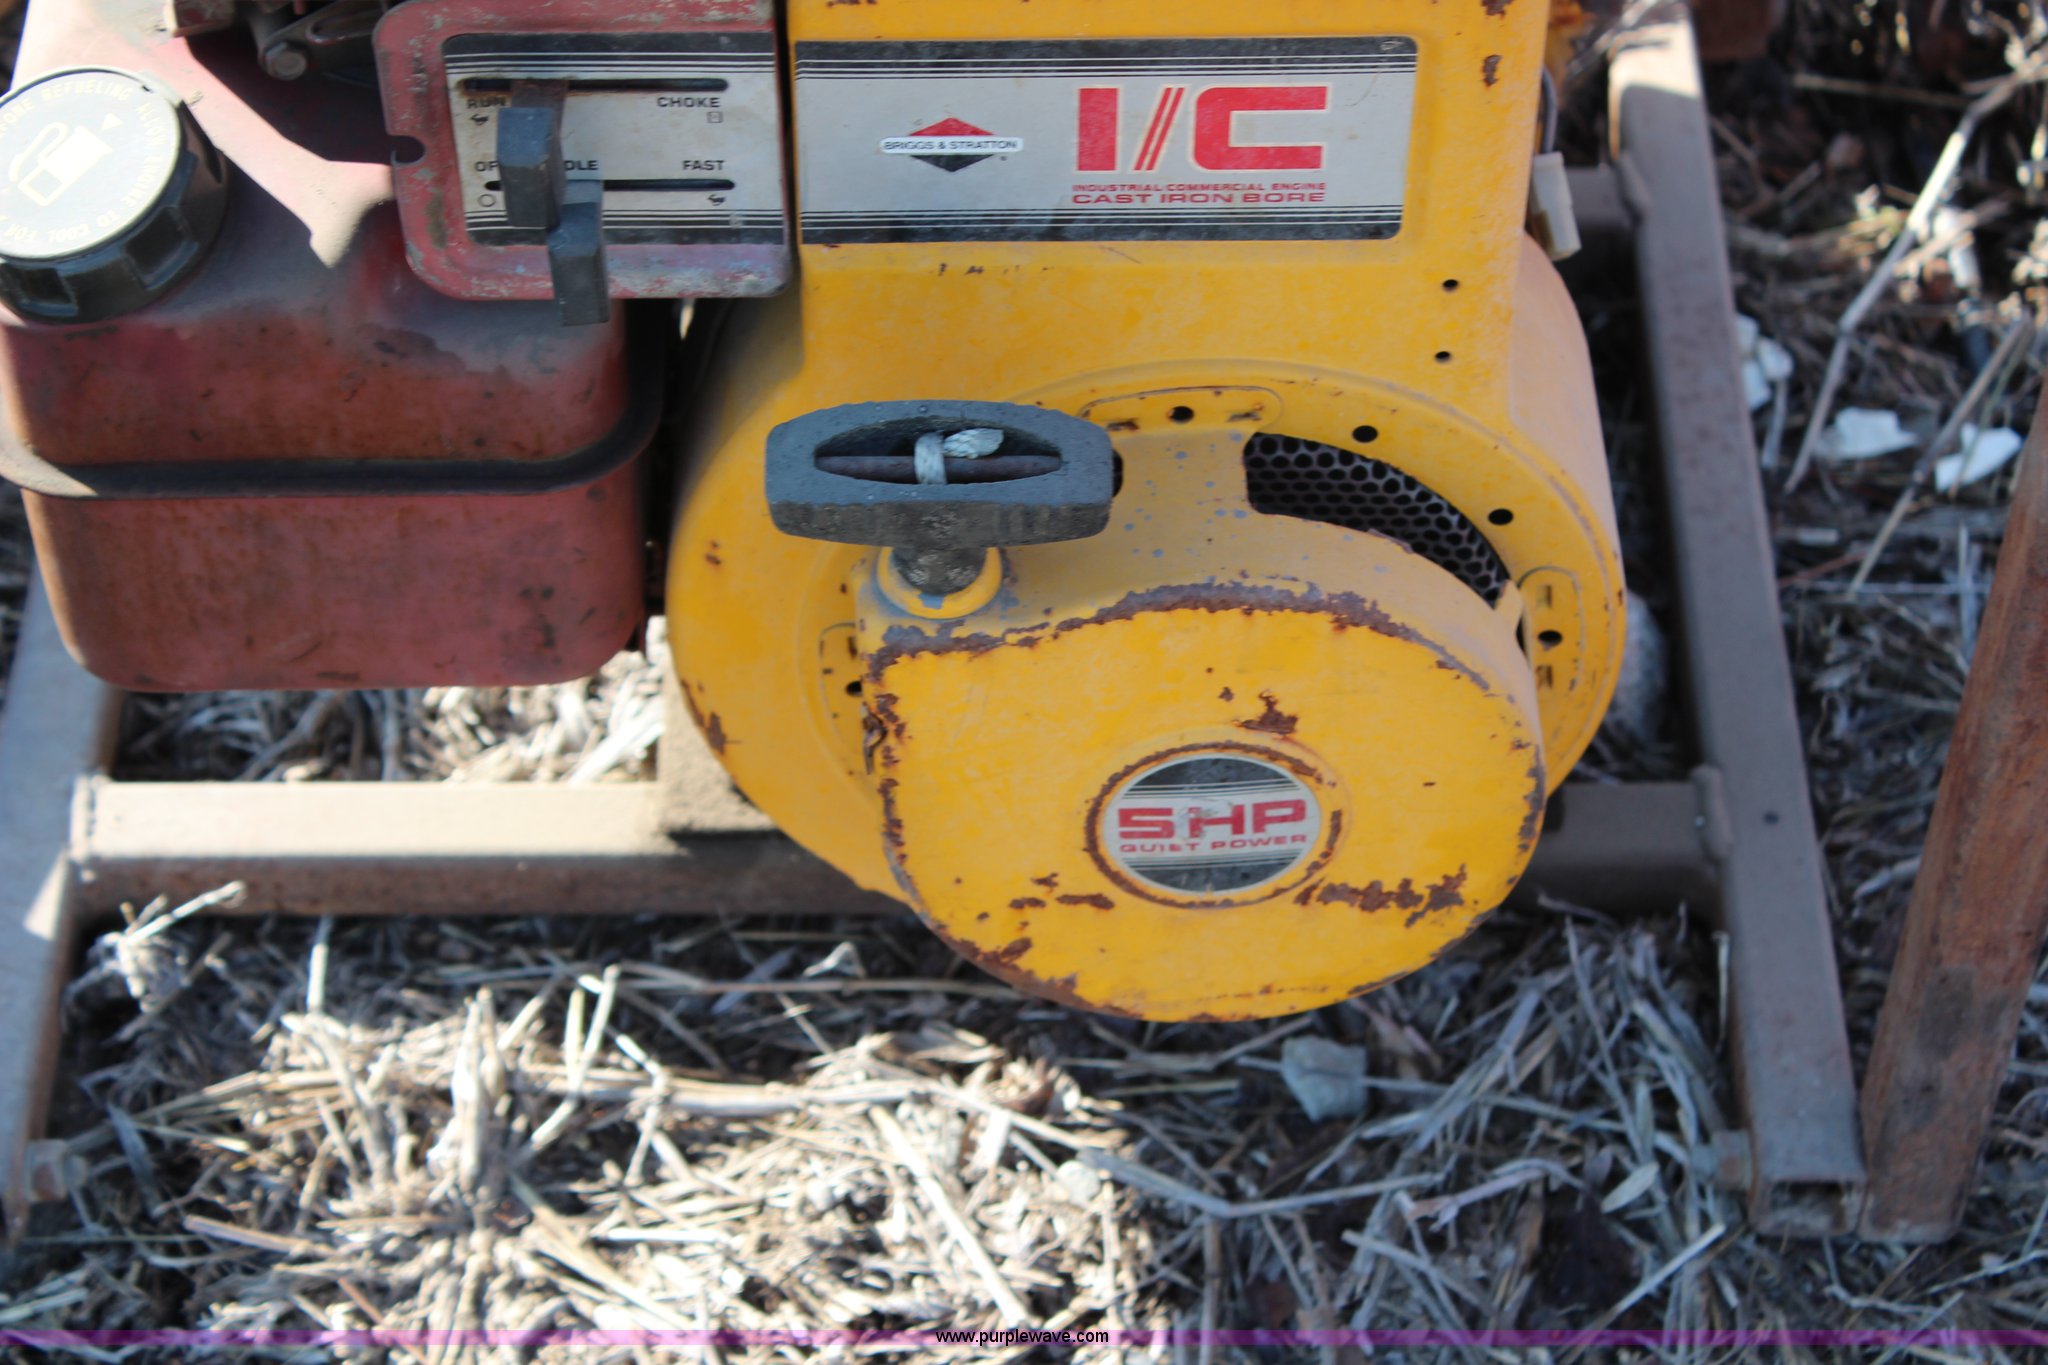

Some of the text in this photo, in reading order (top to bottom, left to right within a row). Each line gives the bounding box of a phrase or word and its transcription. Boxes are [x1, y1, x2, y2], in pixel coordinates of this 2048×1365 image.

[467, 97, 506, 109] RUN
[657, 96, 722, 108] CHOKE
[883, 139, 1018, 150] BRIGGS & STRATTON
[474, 161, 499, 172] OF
[564, 160, 599, 171] DLE
[682, 160, 727, 171] FAST
[1271, 182, 1327, 192] ENGINE
[1071, 192, 1326, 205] CAST IRON BORE
[47, 223, 91, 244] COOL
[1119, 834, 1308, 853] QUIET POWER
